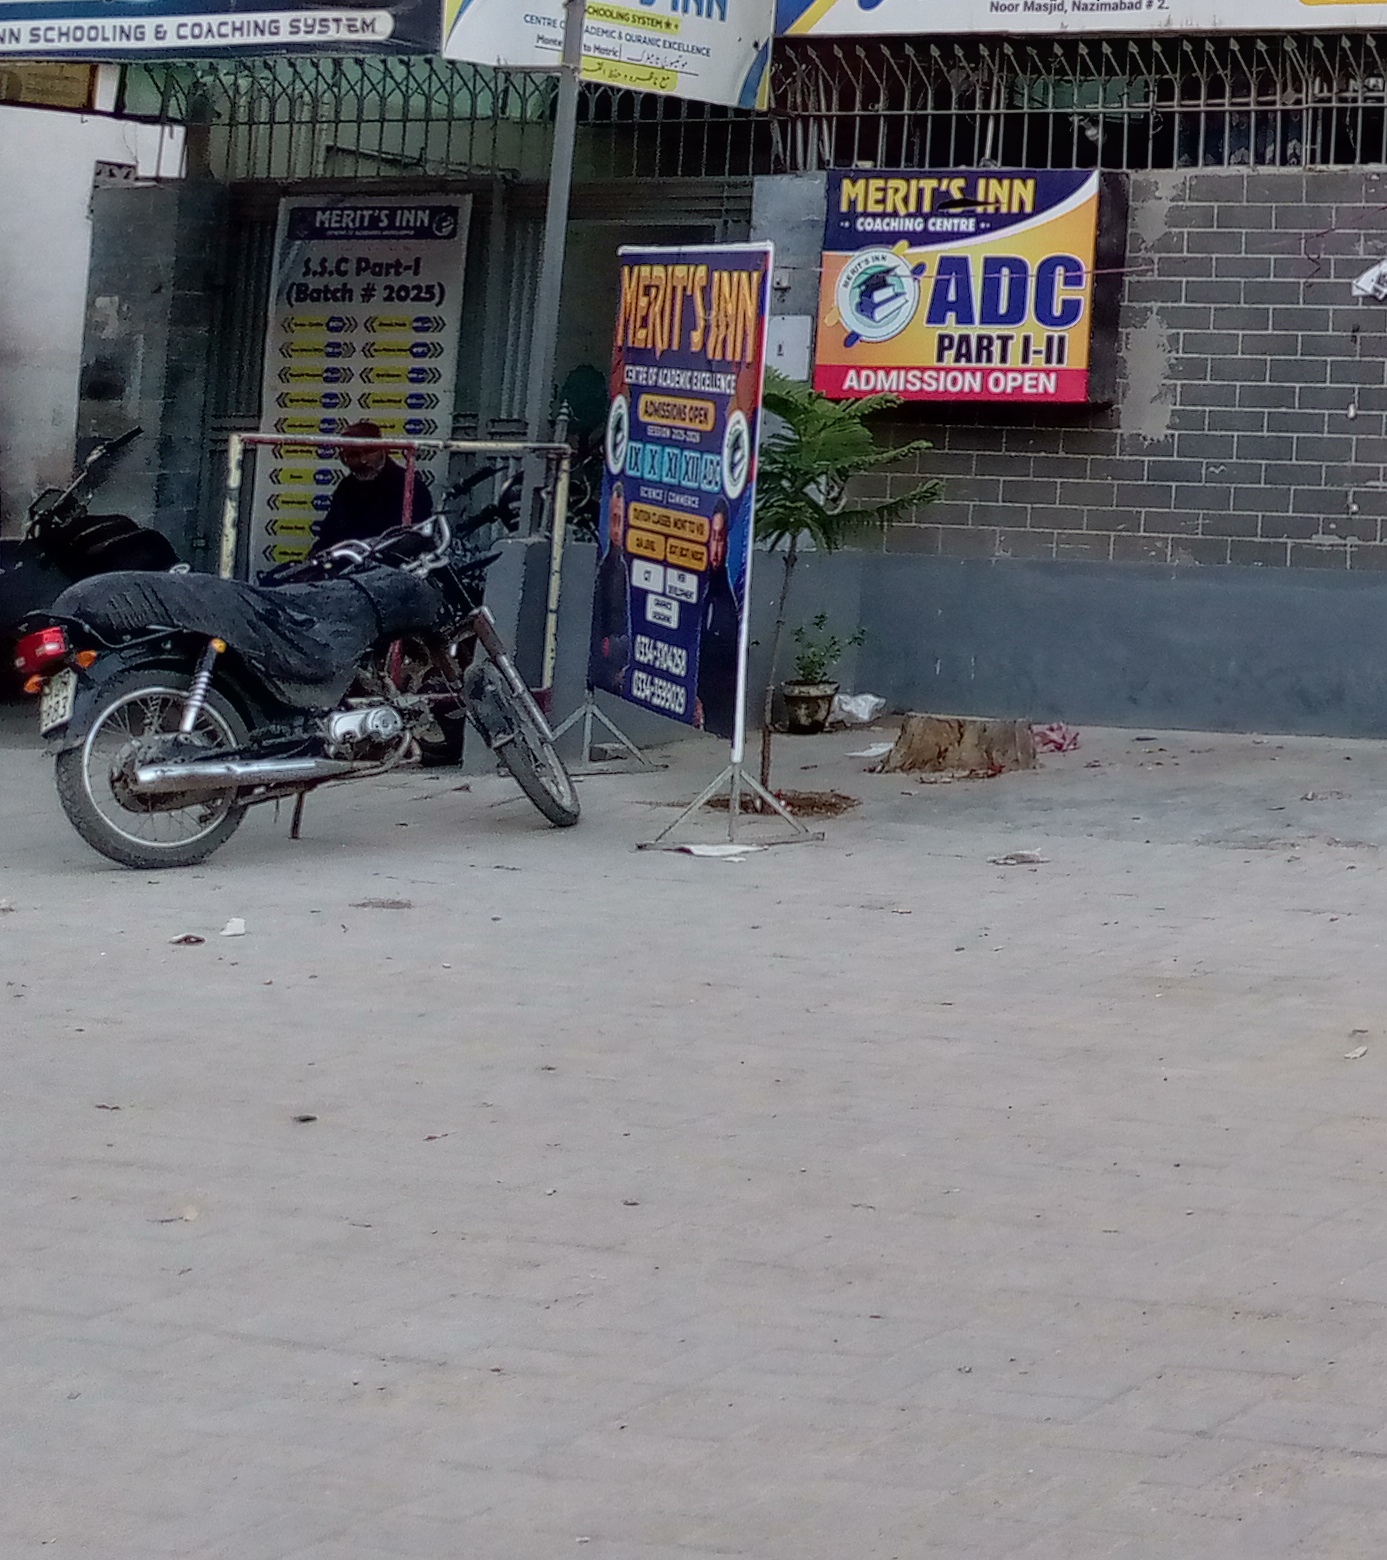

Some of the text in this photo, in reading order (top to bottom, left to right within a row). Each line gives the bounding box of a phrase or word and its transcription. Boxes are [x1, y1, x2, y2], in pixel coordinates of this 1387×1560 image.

[631, 12, 663, 29] SYSTEM
[989, 0, 1020, 13] Noor
[1023, 0, 1068, 15] Masjid,
[1145, 0, 1154, 10] #
[29, 24, 146, 44] SCHOOLING
[155, 24, 167, 40] &
[176, 19, 281, 40] COACHING
[289, 17, 376, 36] SYSTEM
[523, 13, 558, 29] CENTRE
[625, 32, 661, 50] QURANIC
[663, 38, 711, 57] EXCELLENCE
[593, 44, 619, 57] Matric
[840, 178, 1036, 216] MERIT'S INN
[315, 209, 430, 229] MERIT'S INN
[856, 217, 976, 233] COACHING CENTRE
[302, 256, 422, 278] S.S.C Part-I
[842, 254, 888, 289] MERIT'S INN
[286, 282, 446, 308] (Batch # 2025)
[924, 254, 1086, 328] ADC
[617, 264, 762, 363] MERIT'S INN
[936, 333, 1067, 366] PART I-II
[657, 369, 692, 391] ACADEMIC
[692, 371, 736, 394] EXCELLENCE
[843, 369, 1057, 393] ADMISSION OPEN
[643, 400, 710, 426] ADMISSIONS OPEN
[630, 444, 642, 471] IX
[649, 448, 659, 476] X
[666, 451, 678, 479] XI
[682, 454, 699, 483] XII
